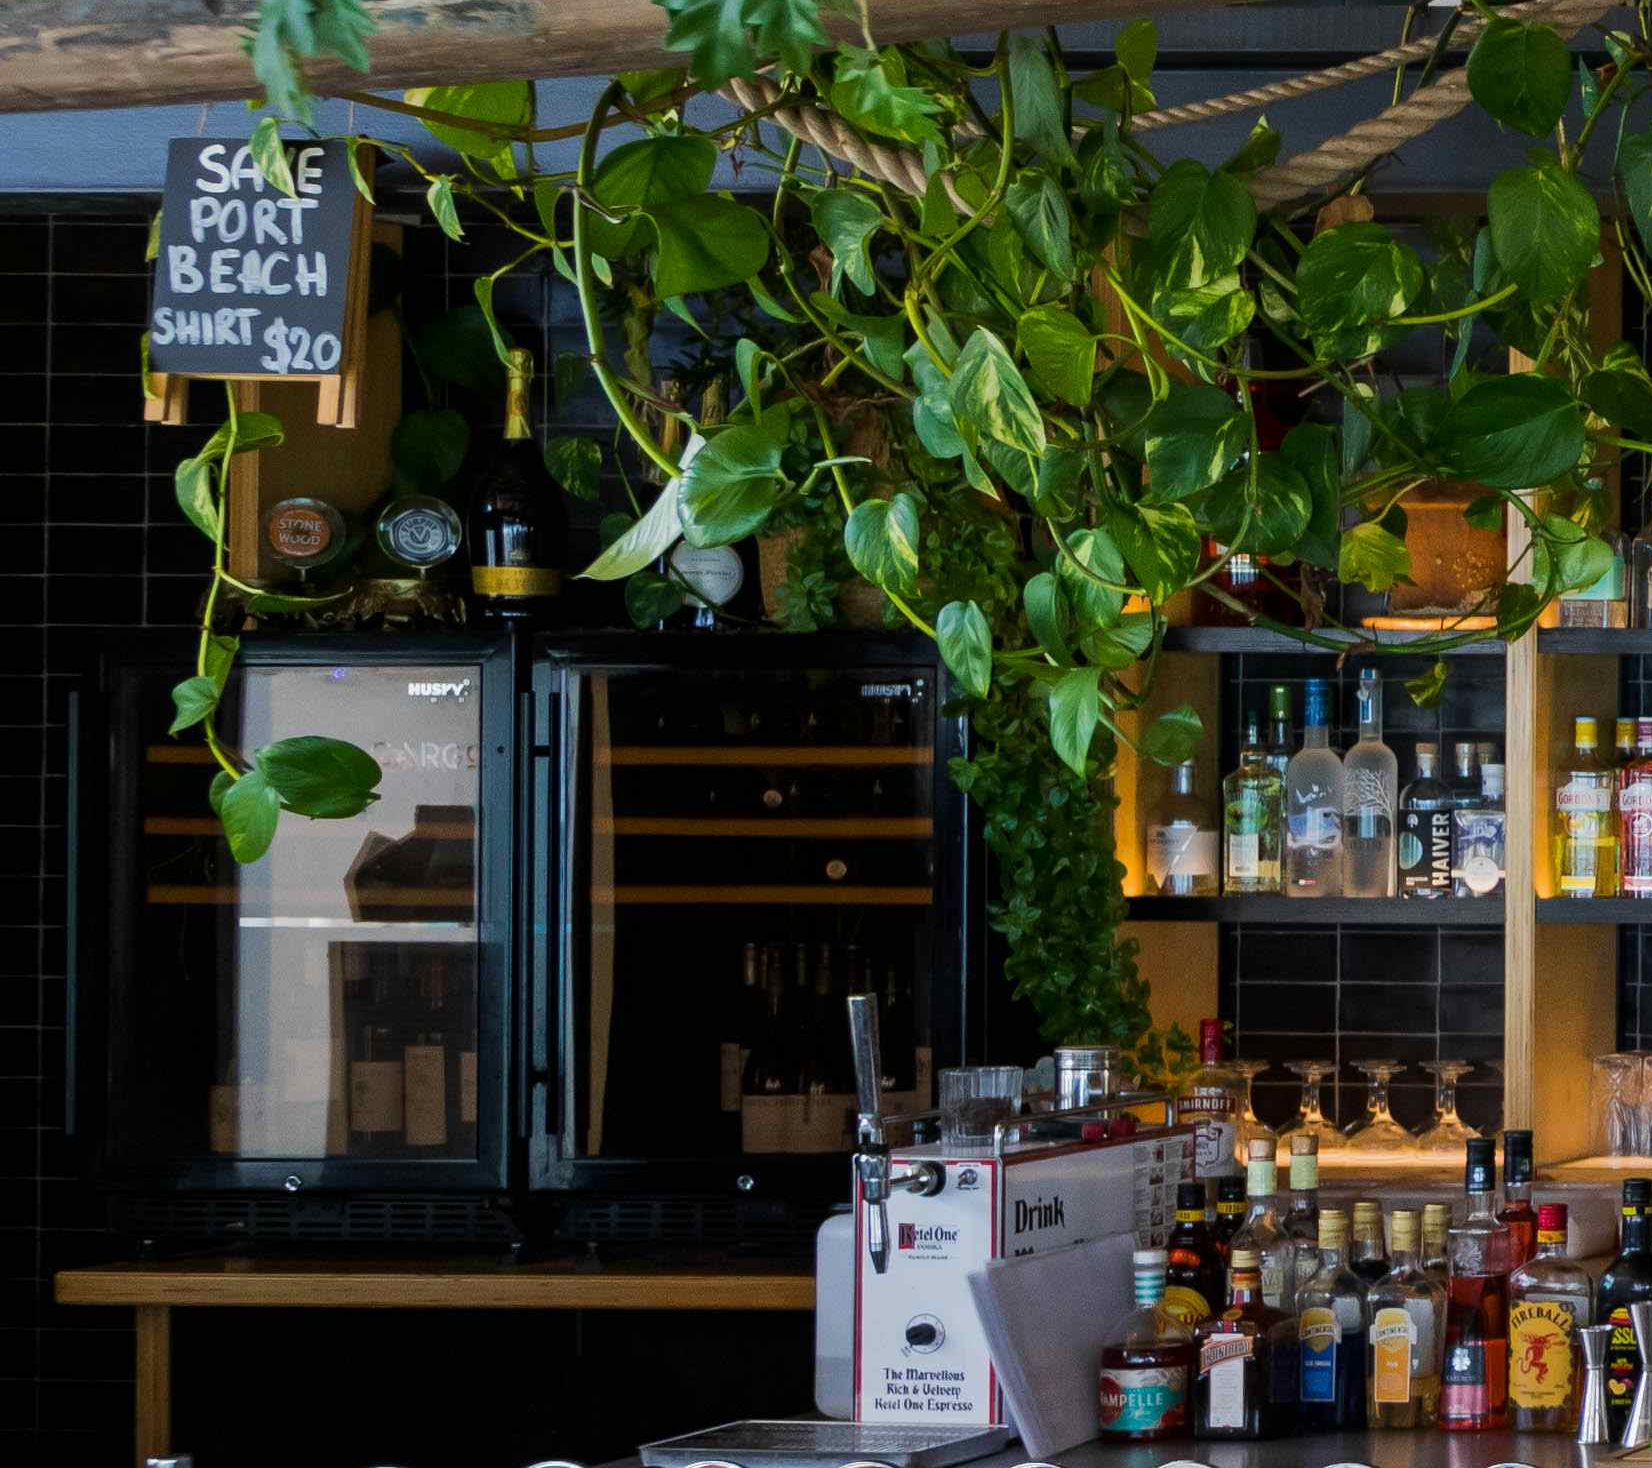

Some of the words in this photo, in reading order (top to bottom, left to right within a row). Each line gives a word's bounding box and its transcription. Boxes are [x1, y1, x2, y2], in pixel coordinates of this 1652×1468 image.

[196, 143, 325, 195] SAE
[190, 198, 319, 246] PORT
[168, 244, 328, 298] BEACH
[151, 306, 261, 345] SHIRT
[260, 314, 342, 374] $20
[1178, 1096, 1234, 1112] SMIRNOFF
[1014, 1196, 1065, 1234] Drink
[934, 1225, 958, 1242] One
[1512, 1306, 1571, 1332] FIREBALL
[883, 1367, 903, 1381] The
[886, 1382, 909, 1396] Rich
[912, 1384, 919, 1395] &
[903, 1399, 924, 1411] One
[926, 1399, 974, 1413] Espresso
